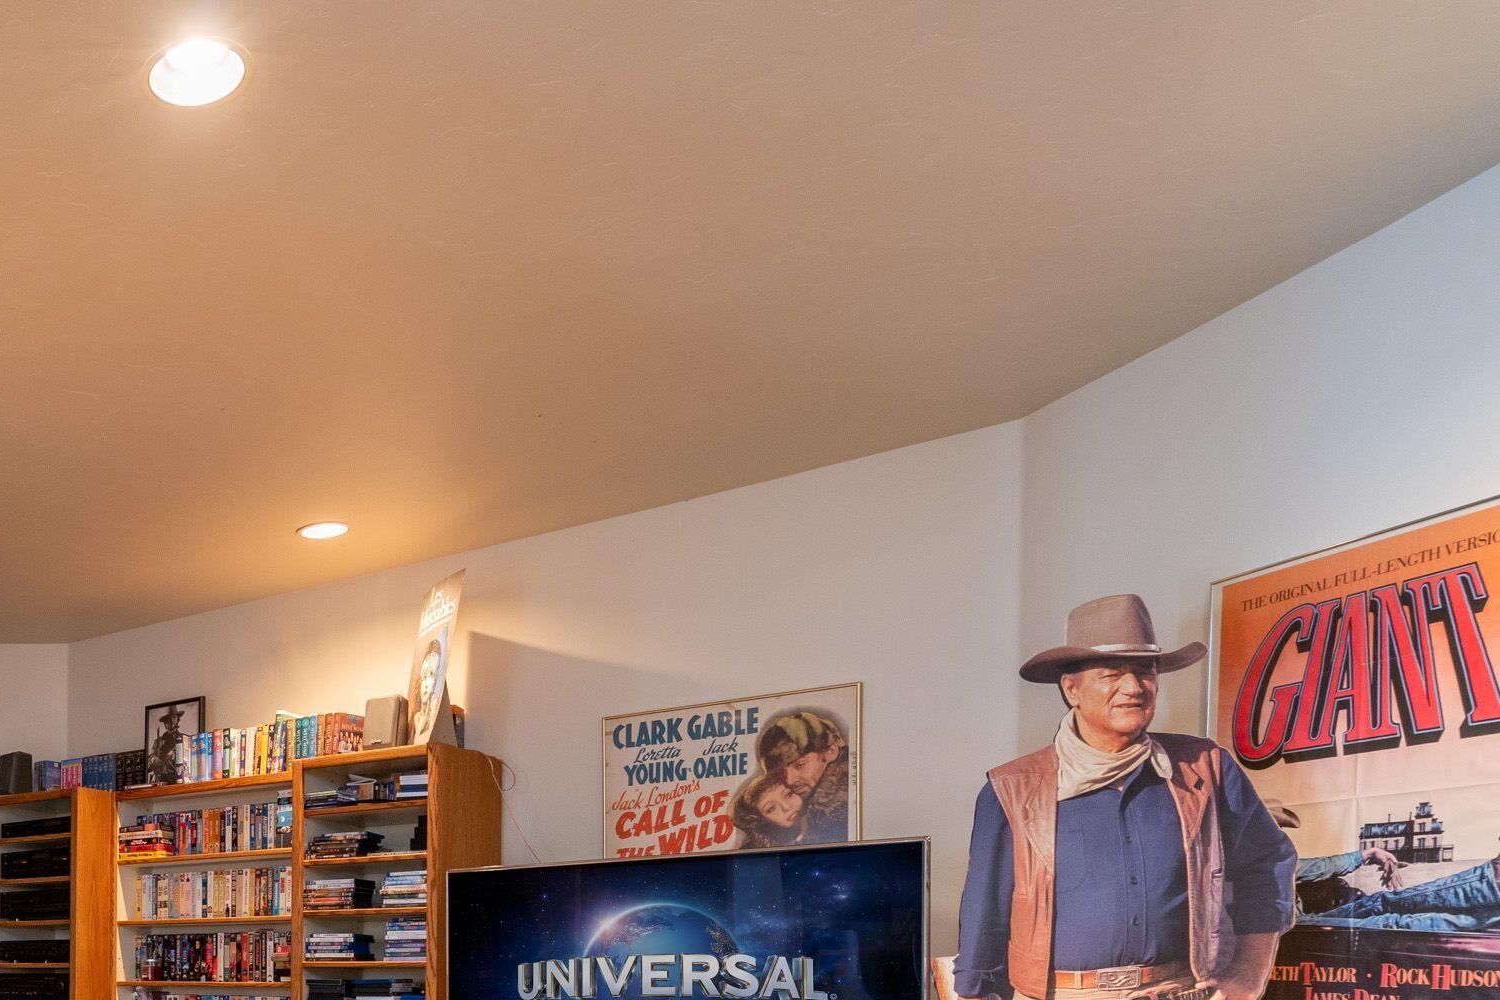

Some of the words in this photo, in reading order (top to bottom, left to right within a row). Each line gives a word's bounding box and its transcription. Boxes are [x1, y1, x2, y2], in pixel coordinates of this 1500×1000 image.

[1241, 595, 1268, 613] THE
[1269, 578, 1333, 604] ORIGINAL
[1334, 547, 1442, 588] FULL-LENGTH
[1232, 561, 1500, 770] GIANT
[612, 716, 684, 750] CLARK
[686, 706, 759, 741] GABLE
[623, 758, 688, 787] YOUNG
[693, 752, 748, 780] OAKIE
[633, 746, 681, 764] Loretta
[702, 737, 740, 756] Jack
[611, 788, 642, 812] Jack
[645, 779, 701, 809] London's
[615, 797, 687, 840] CALL
[693, 788, 730, 817] OF
[657, 813, 734, 857] WILD
[1299, 962, 1357, 985] TAYLOR
[1379, 963, 1431, 988] ROCK
